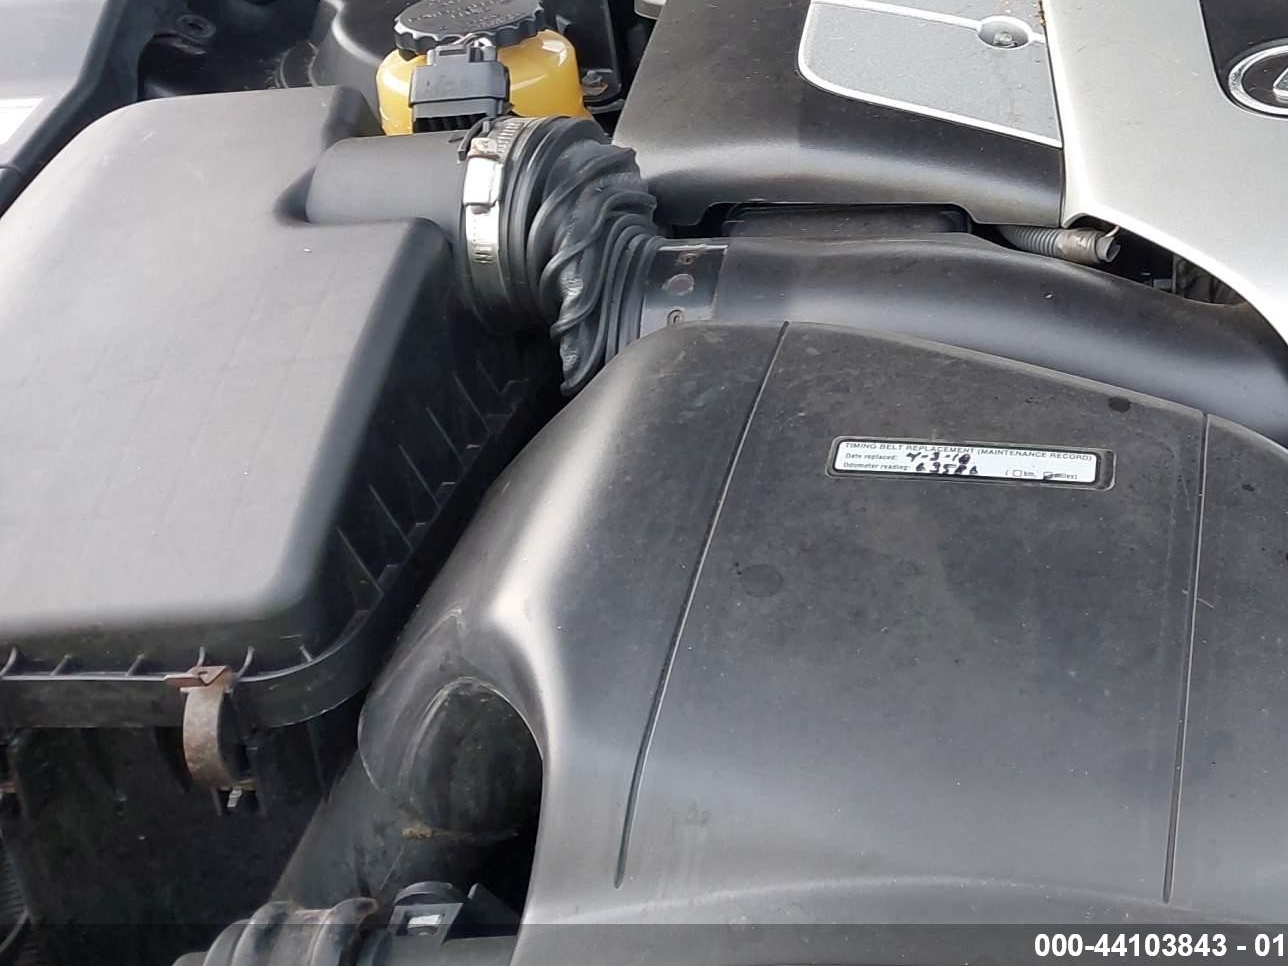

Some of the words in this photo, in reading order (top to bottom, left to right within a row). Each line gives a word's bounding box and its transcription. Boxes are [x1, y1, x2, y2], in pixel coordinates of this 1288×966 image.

[845, 442, 877, 451] TIMING
[879, 443, 903, 452] BELT
[906, 444, 975, 455] REPLACEMENT
[976, 448, 1046, 458] (MAINTENANCE
[1049, 452, 1093, 461] RECORD)
